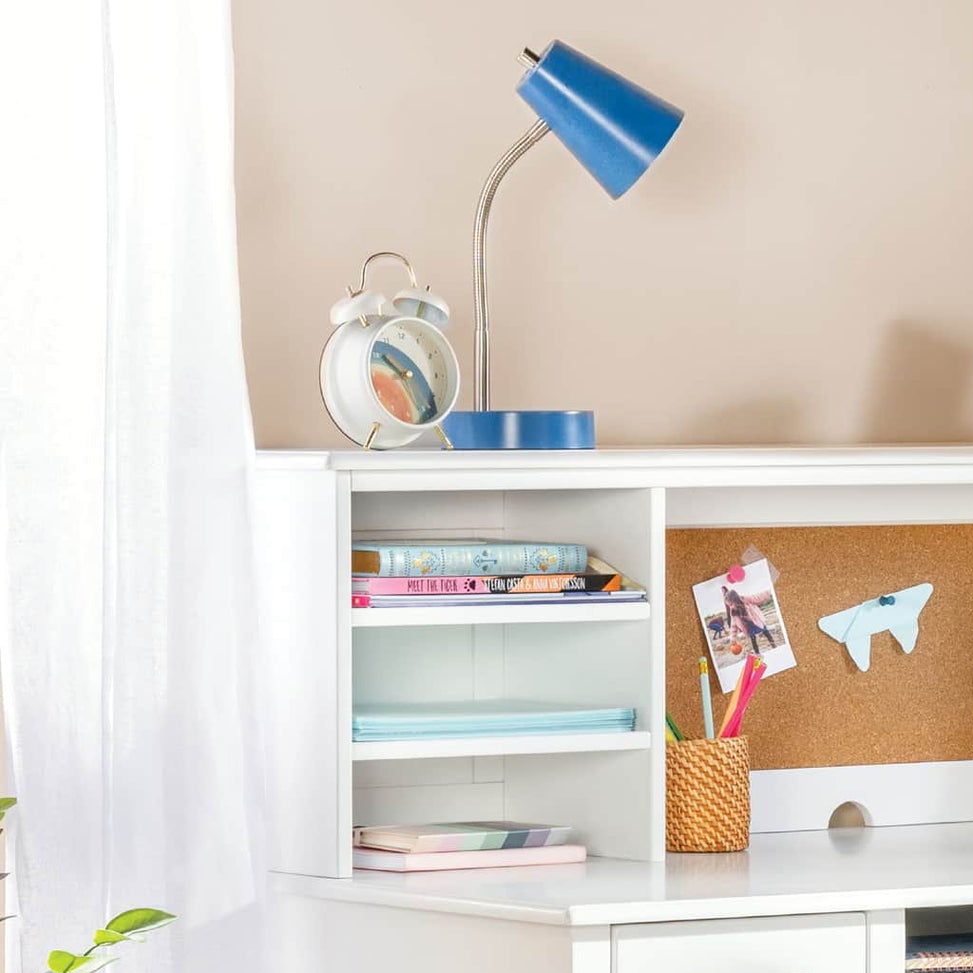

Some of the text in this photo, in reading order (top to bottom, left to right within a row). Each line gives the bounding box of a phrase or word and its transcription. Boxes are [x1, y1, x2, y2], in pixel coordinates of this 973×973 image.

[407, 579, 458, 592] MEET THE TIGER
